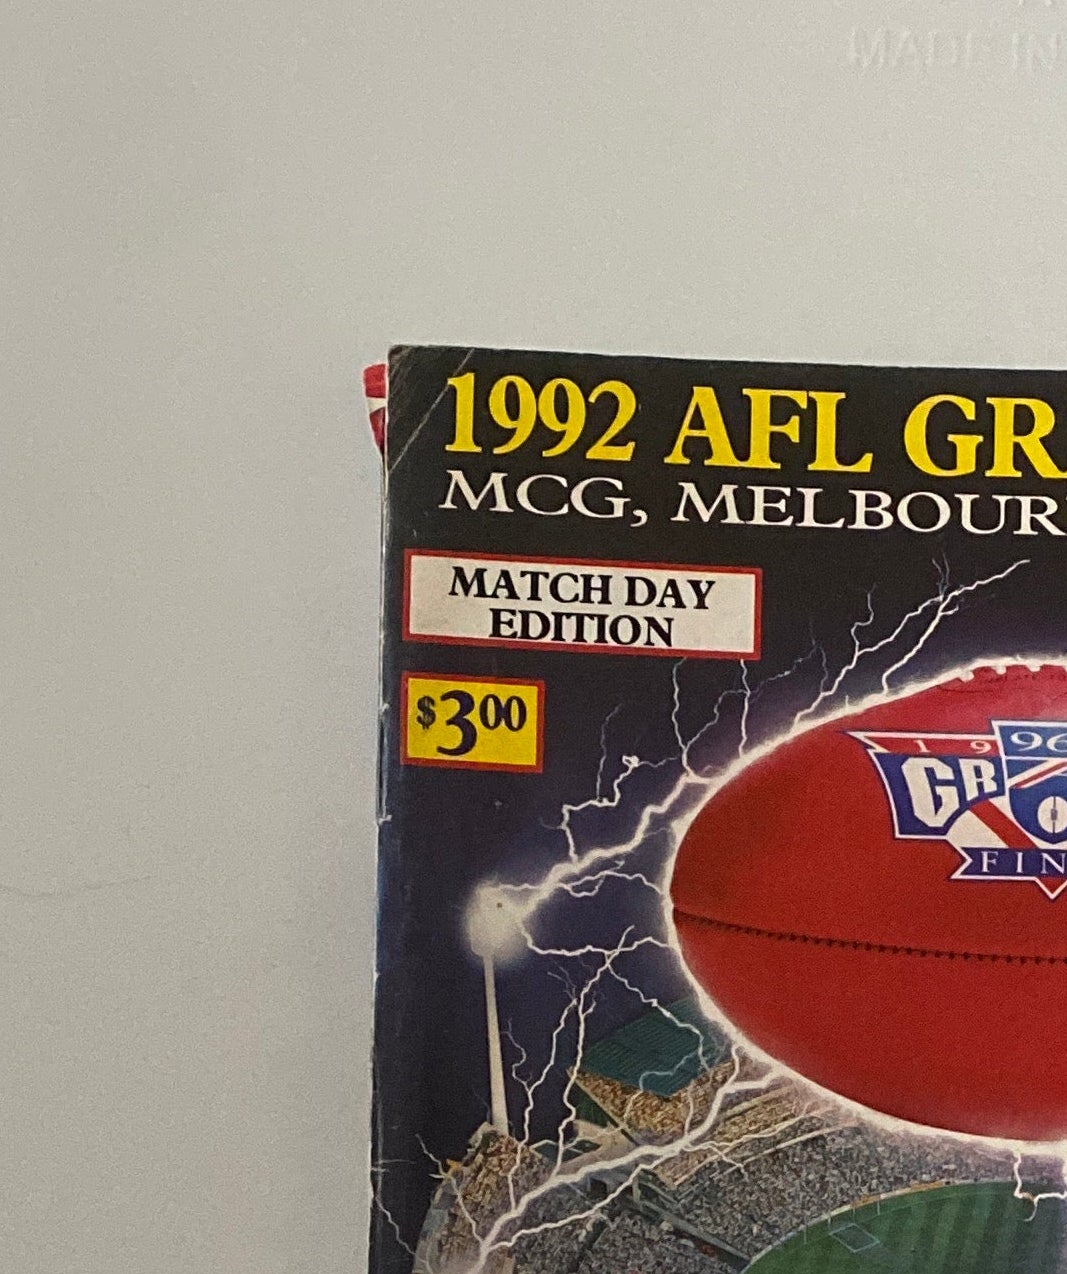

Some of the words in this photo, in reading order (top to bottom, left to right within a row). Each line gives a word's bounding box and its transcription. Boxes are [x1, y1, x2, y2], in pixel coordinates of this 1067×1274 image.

[447, 373, 637, 461] 1992
[665, 386, 873, 472] AFL
[438, 470, 648, 527] MCG,
[449, 566, 613, 605] MATCH
[624, 574, 716, 611] DAY
[488, 607, 674, 648] EDITION
